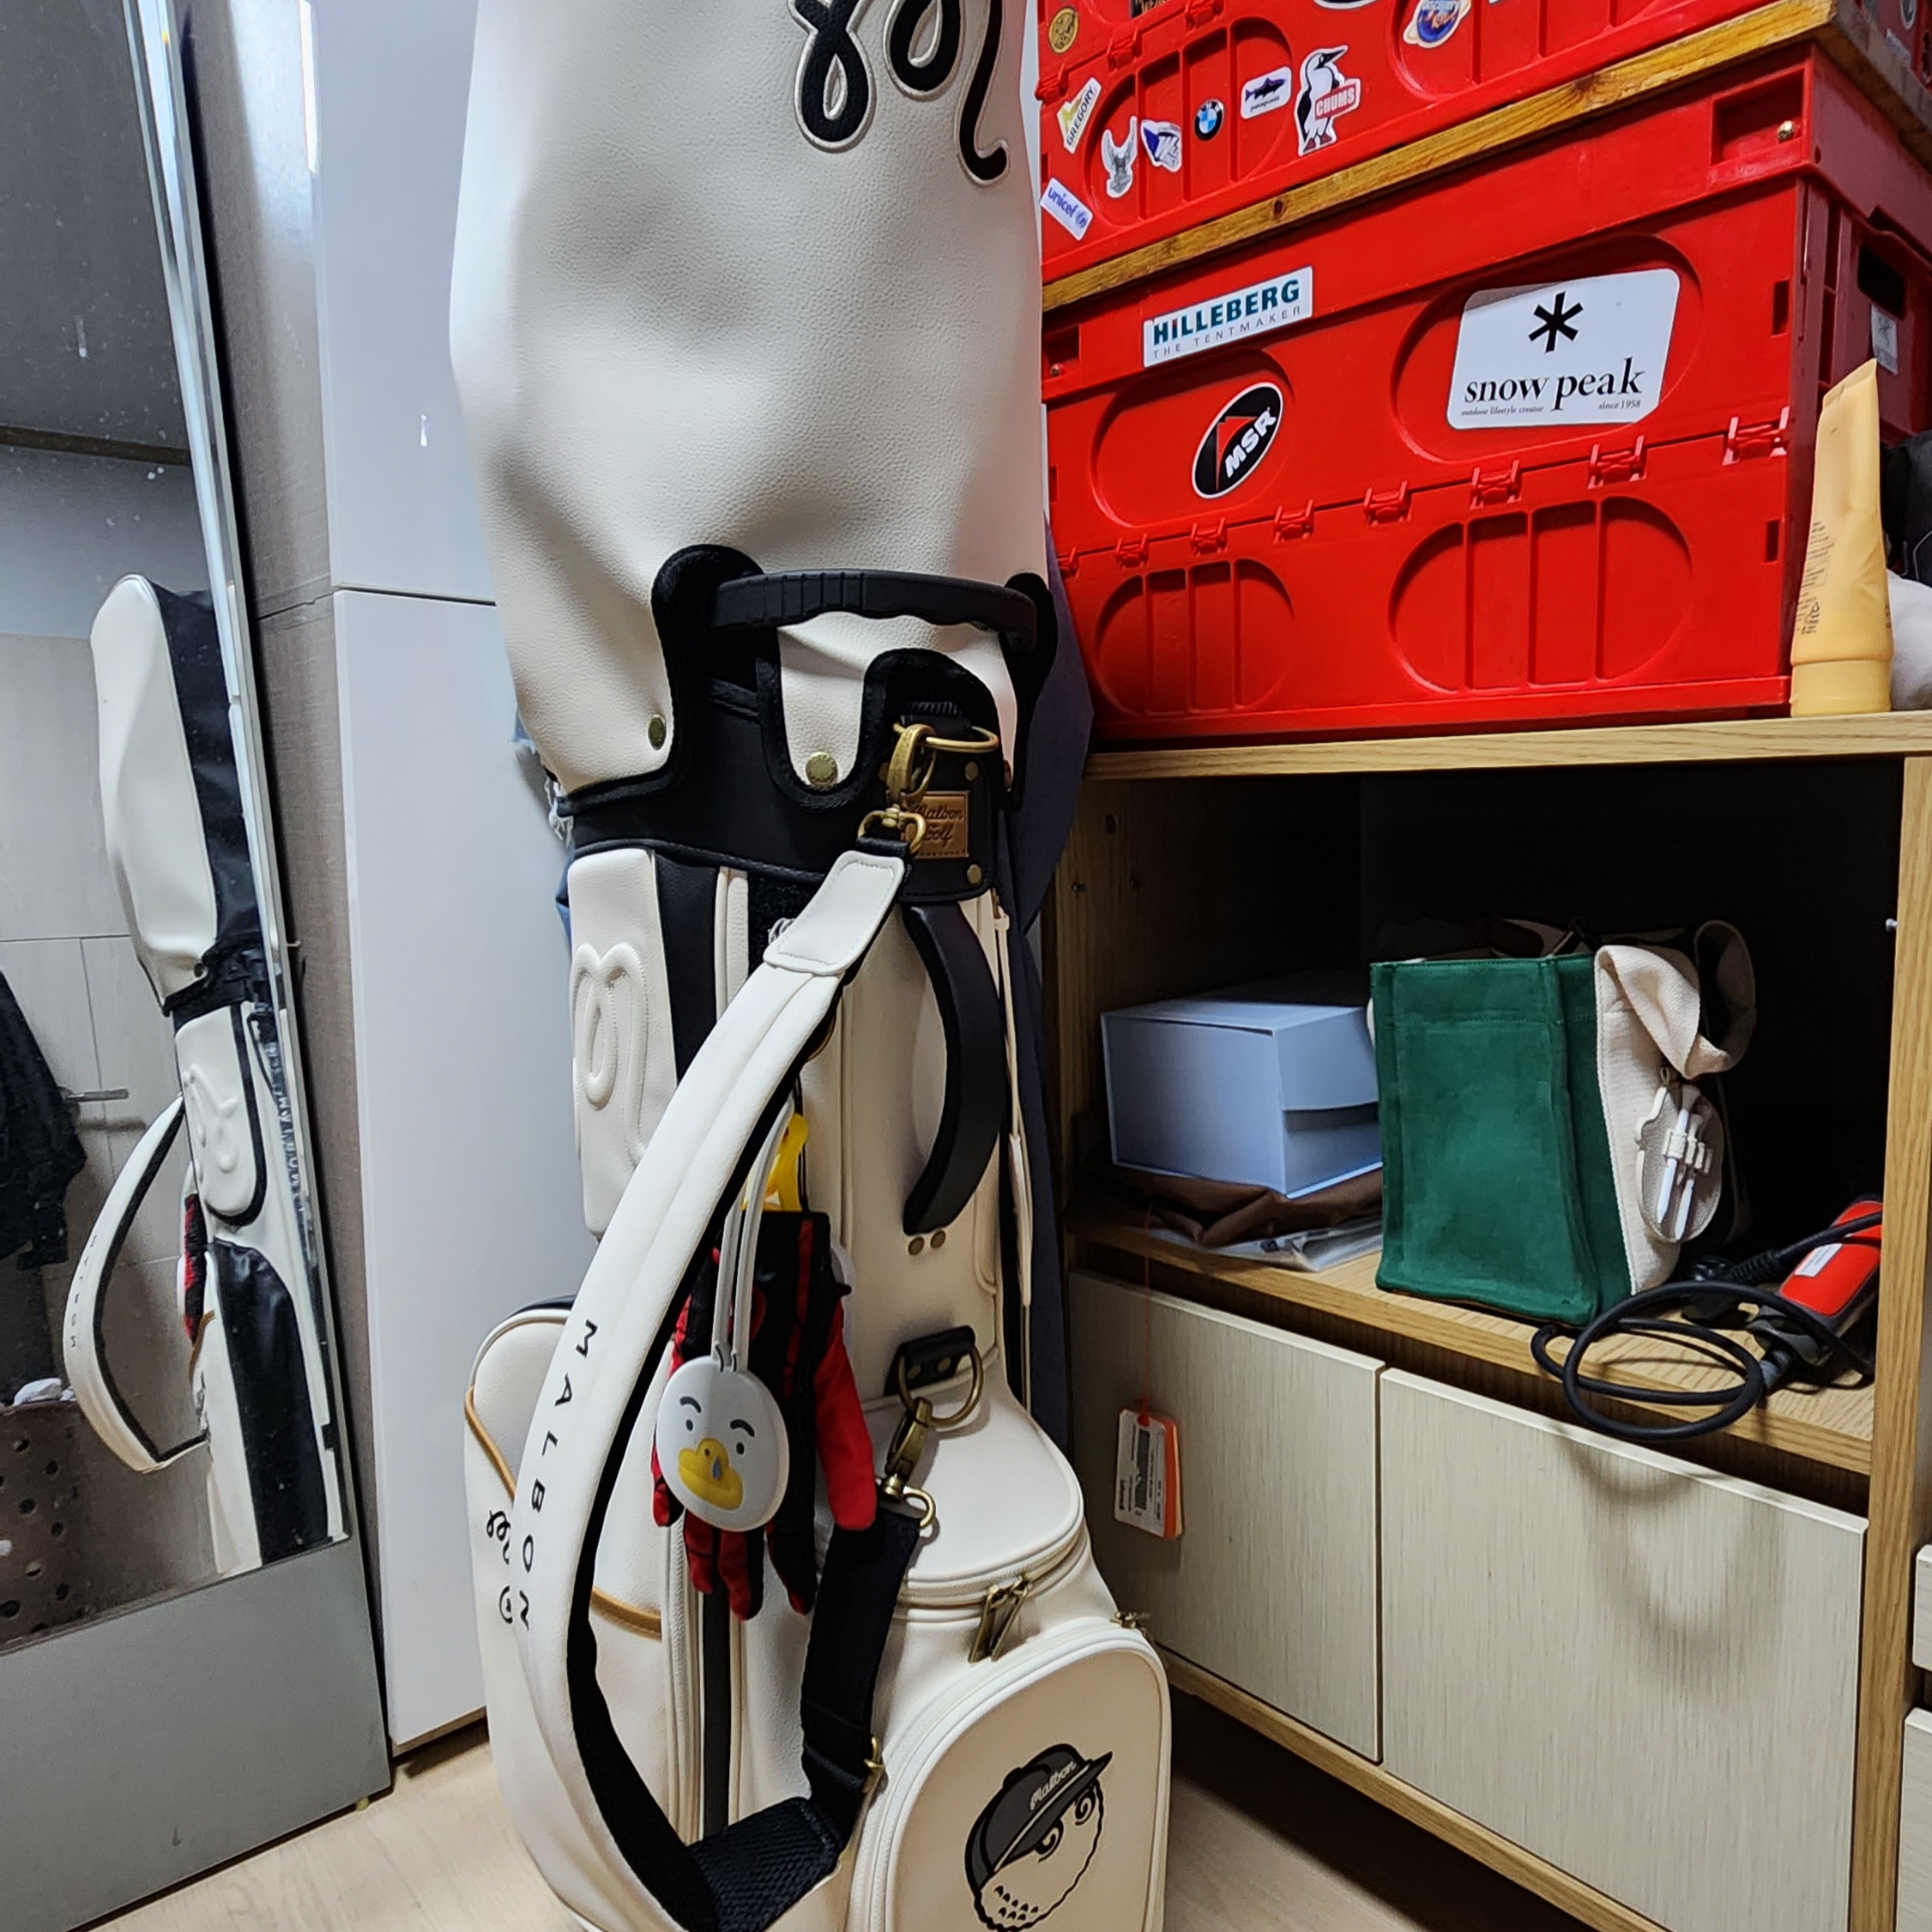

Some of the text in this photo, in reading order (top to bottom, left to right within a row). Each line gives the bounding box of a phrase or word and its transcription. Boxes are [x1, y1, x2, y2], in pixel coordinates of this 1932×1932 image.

[1066, 85, 1095, 146] GREGORY
[1316, 87, 1355, 117] CHUMS
[1048, 186, 1078, 218] unicef
[1153, 279, 1300, 346] HILLEBERG
[1153, 305, 1301, 359] THE TENTMAKER
[1464, 356, 1645, 412] snow peak
[1489, 405, 1516, 415] lifestyle
[1598, 401, 1619, 410] since
[1621, 400, 1641, 409] 1958
[1225, 409, 1277, 478] MSR
[519, 1319, 599, 1632] MALBON
[1030, 1761, 1078, 1810] Malbon
